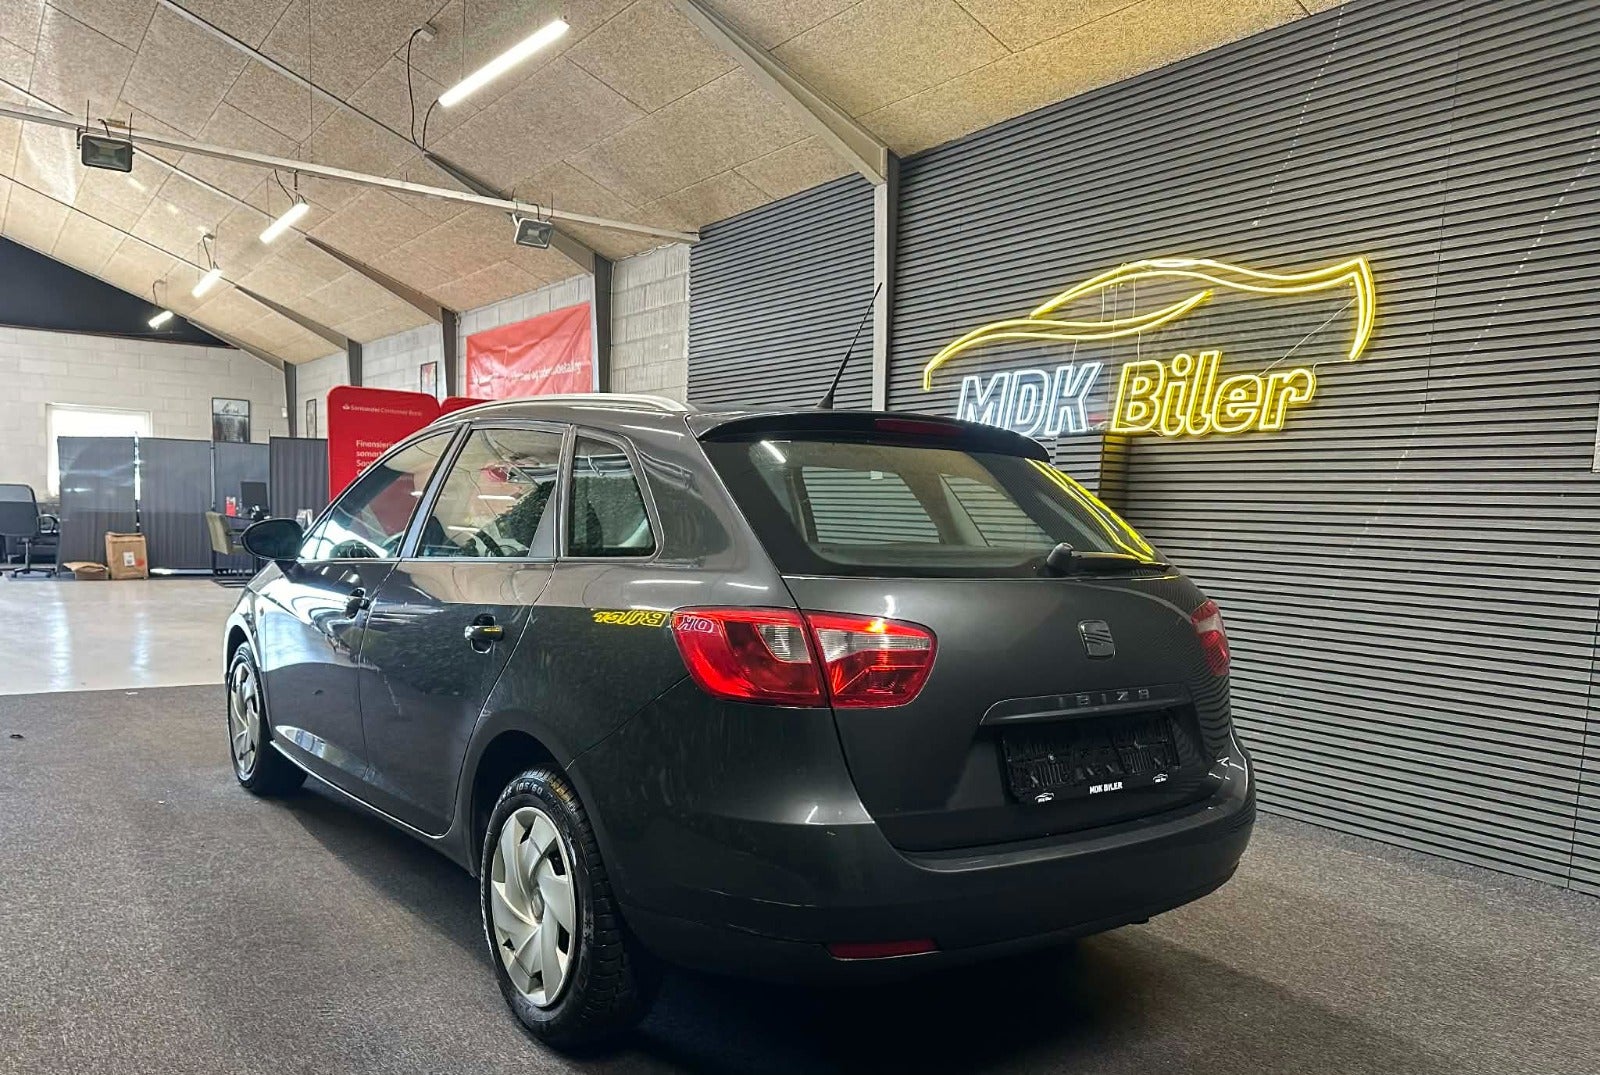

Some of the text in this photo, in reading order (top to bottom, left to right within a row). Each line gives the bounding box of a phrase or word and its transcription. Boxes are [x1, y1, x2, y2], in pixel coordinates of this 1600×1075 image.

[956, 350, 1316, 437] MDK Biler
[1058, 688, 1150, 707] IBIZA
